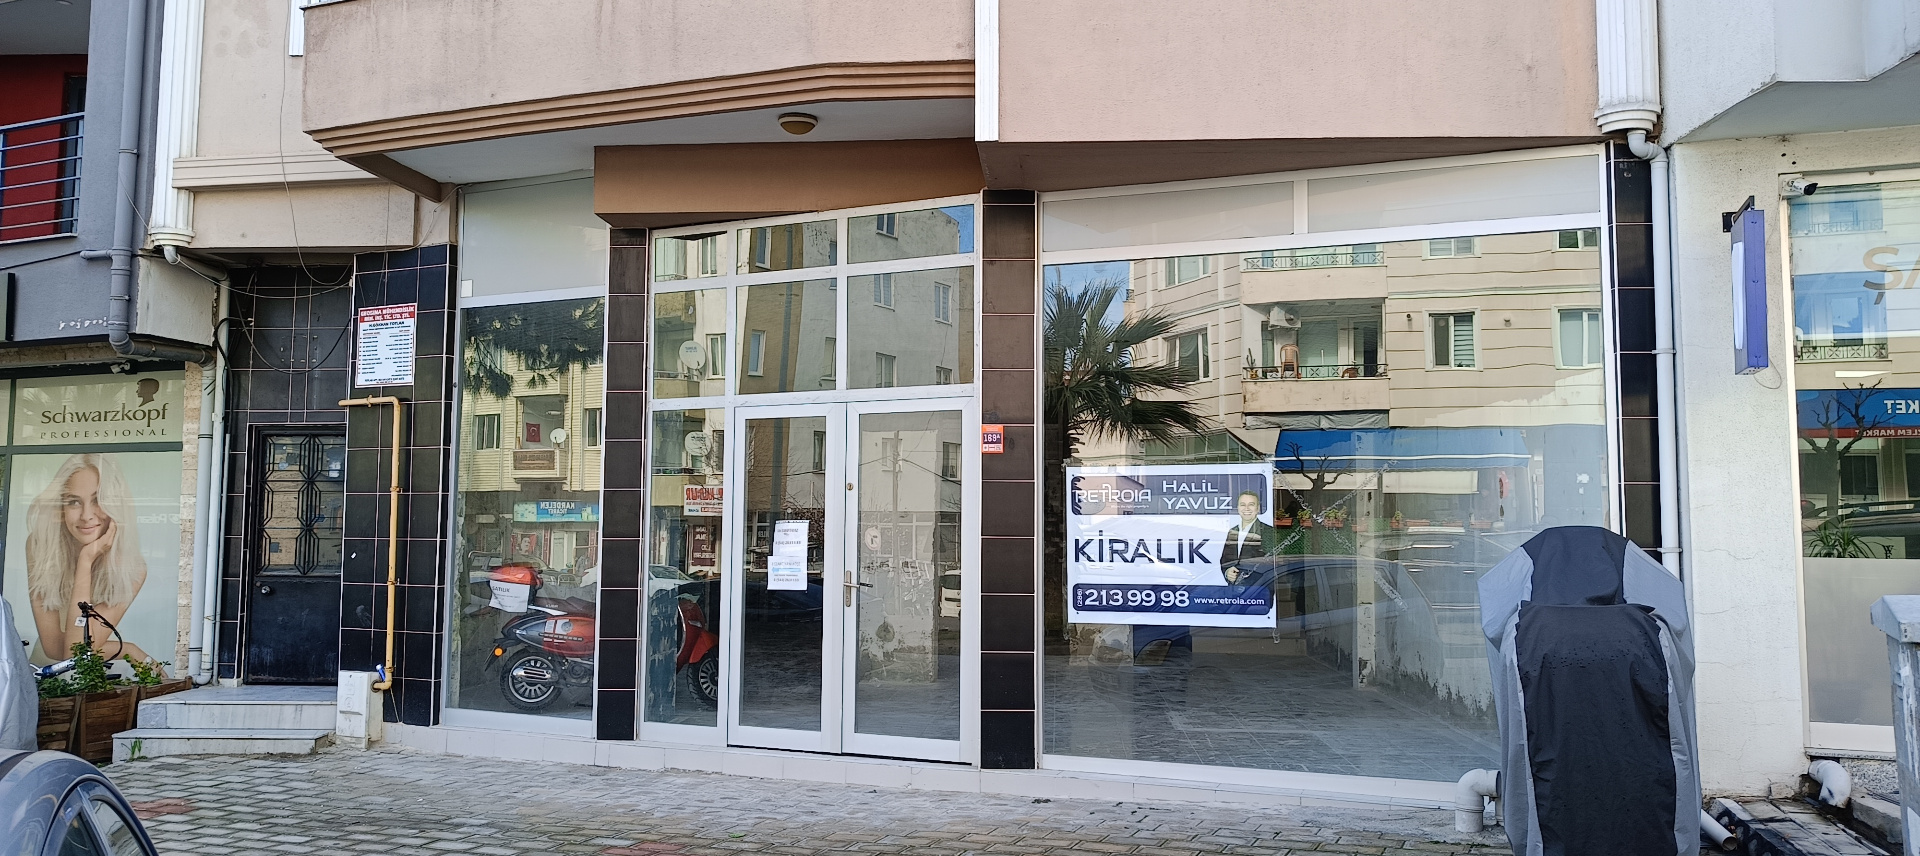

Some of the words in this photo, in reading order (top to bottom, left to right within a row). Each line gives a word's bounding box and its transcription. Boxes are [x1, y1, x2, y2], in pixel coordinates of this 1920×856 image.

[41, 429, 167, 439] PROFESSIONAL
[1163, 497, 1233, 510] YAVUZ
[1074, 530, 1212, 564] KİRALIK
[1085, 589, 1123, 606] 213
[1127, 589, 1156, 607] 99
[1160, 589, 1190, 607] 98
